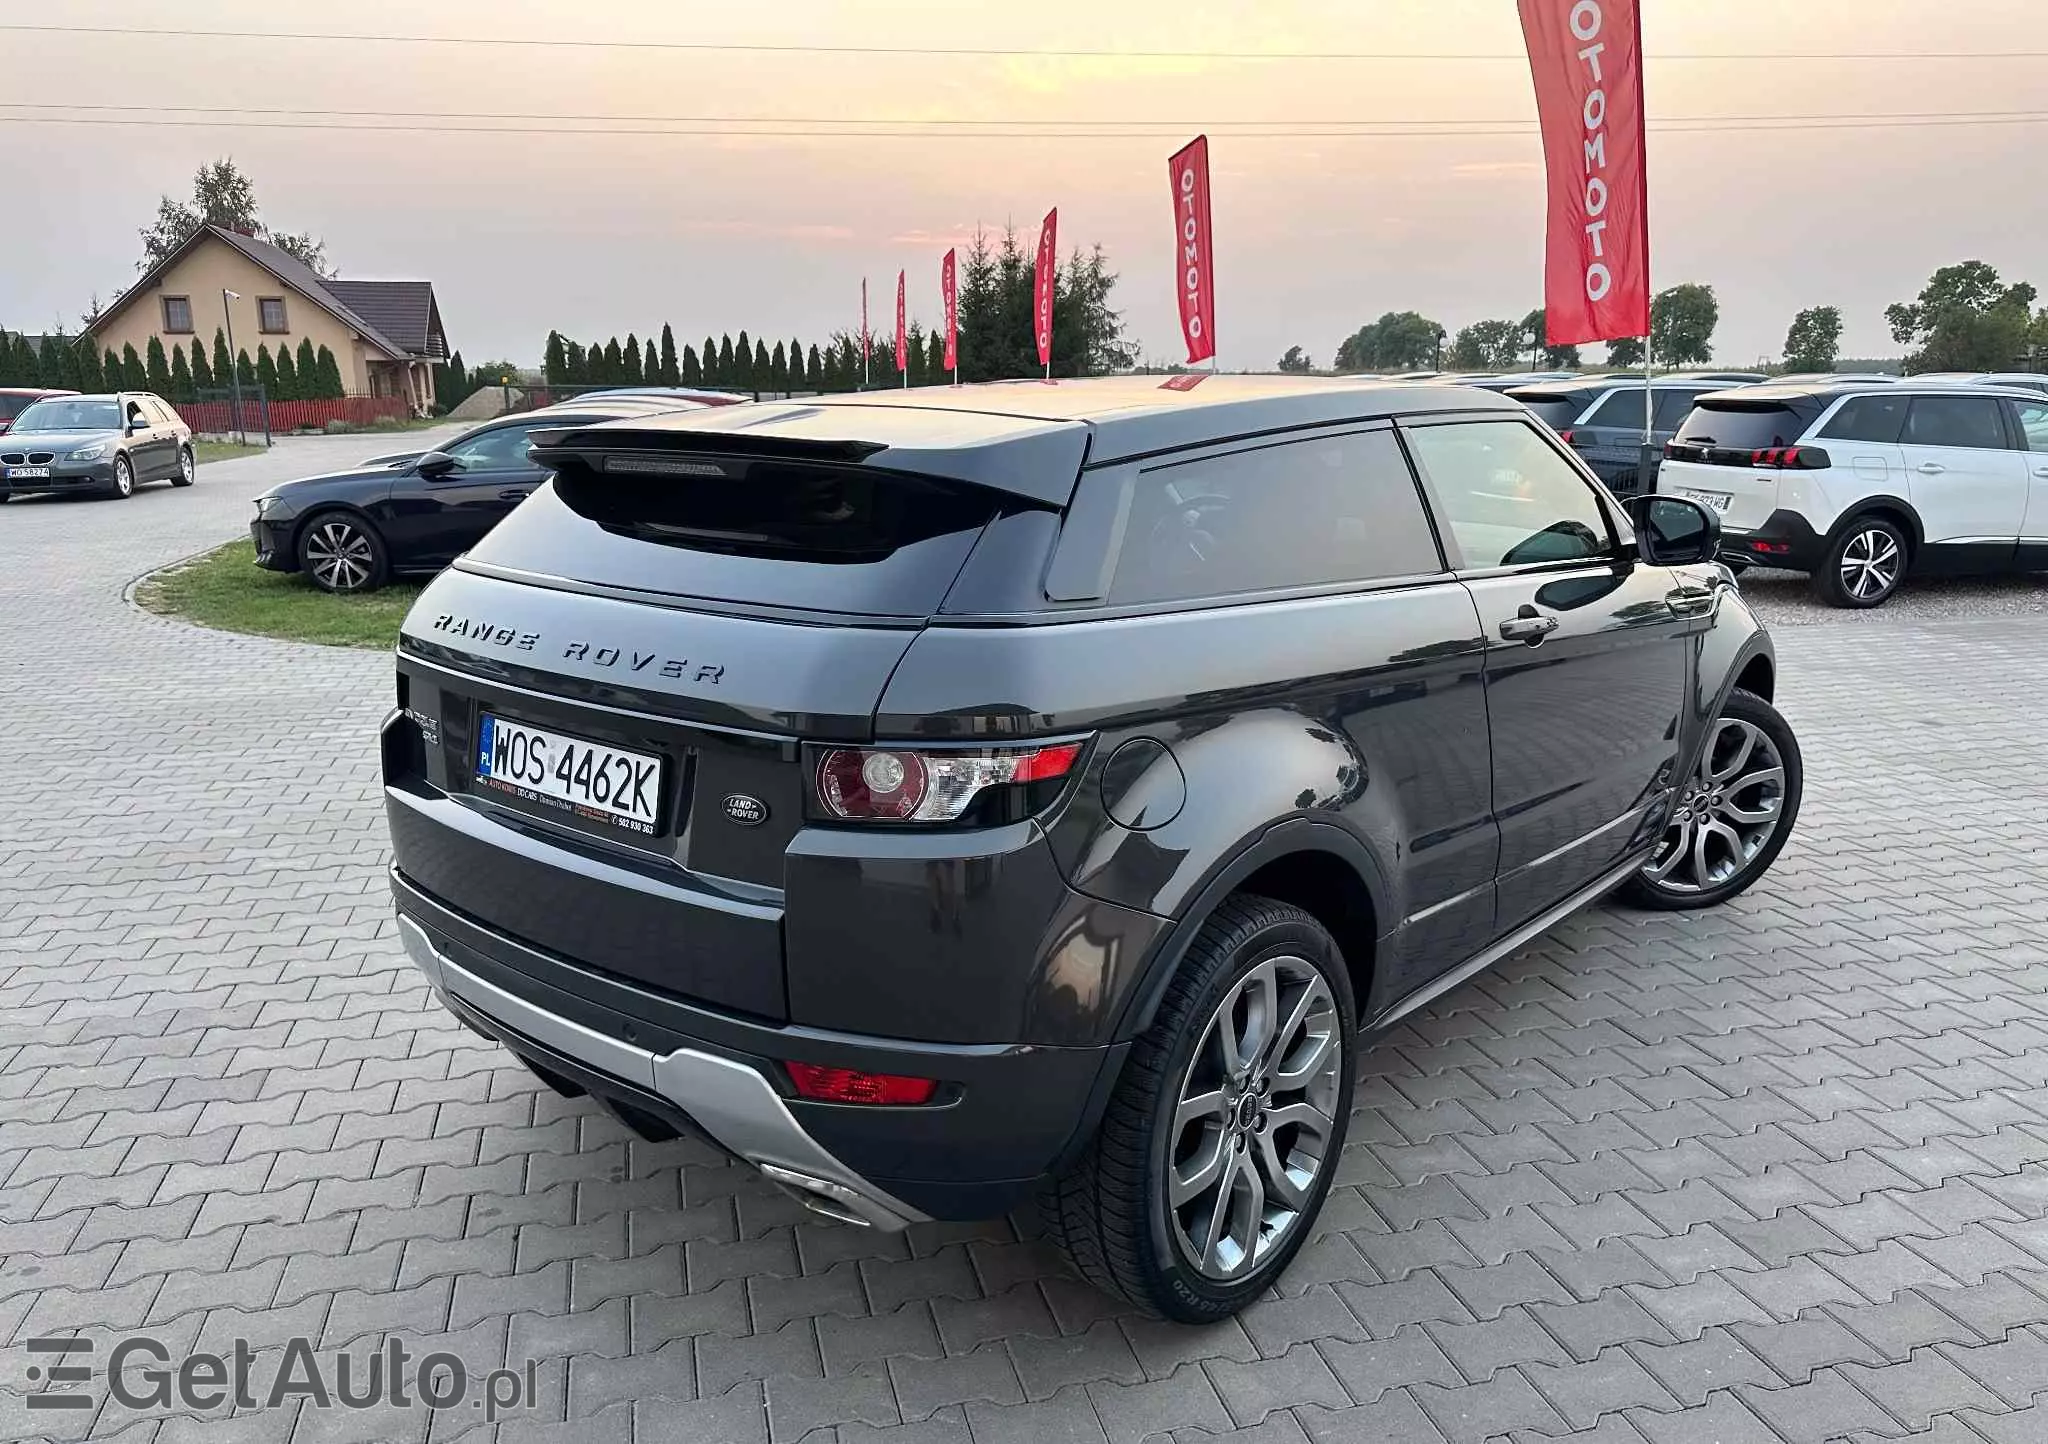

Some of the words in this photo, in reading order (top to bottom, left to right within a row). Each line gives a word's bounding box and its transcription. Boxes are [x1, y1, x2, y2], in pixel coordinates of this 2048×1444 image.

[1568, 0, 1612, 302] OTOMOTO
[1180, 168, 1202, 338] OTOMOTO
[433, 615, 541, 651] RANGE
[562, 640, 725, 684] ROVER
[481, 751, 491, 767] PL
[493, 724, 547, 785] WOS
[555, 744, 656, 818] 4462K
[730, 798, 752, 810] LAND
[731, 807, 759, 820] ROVER
